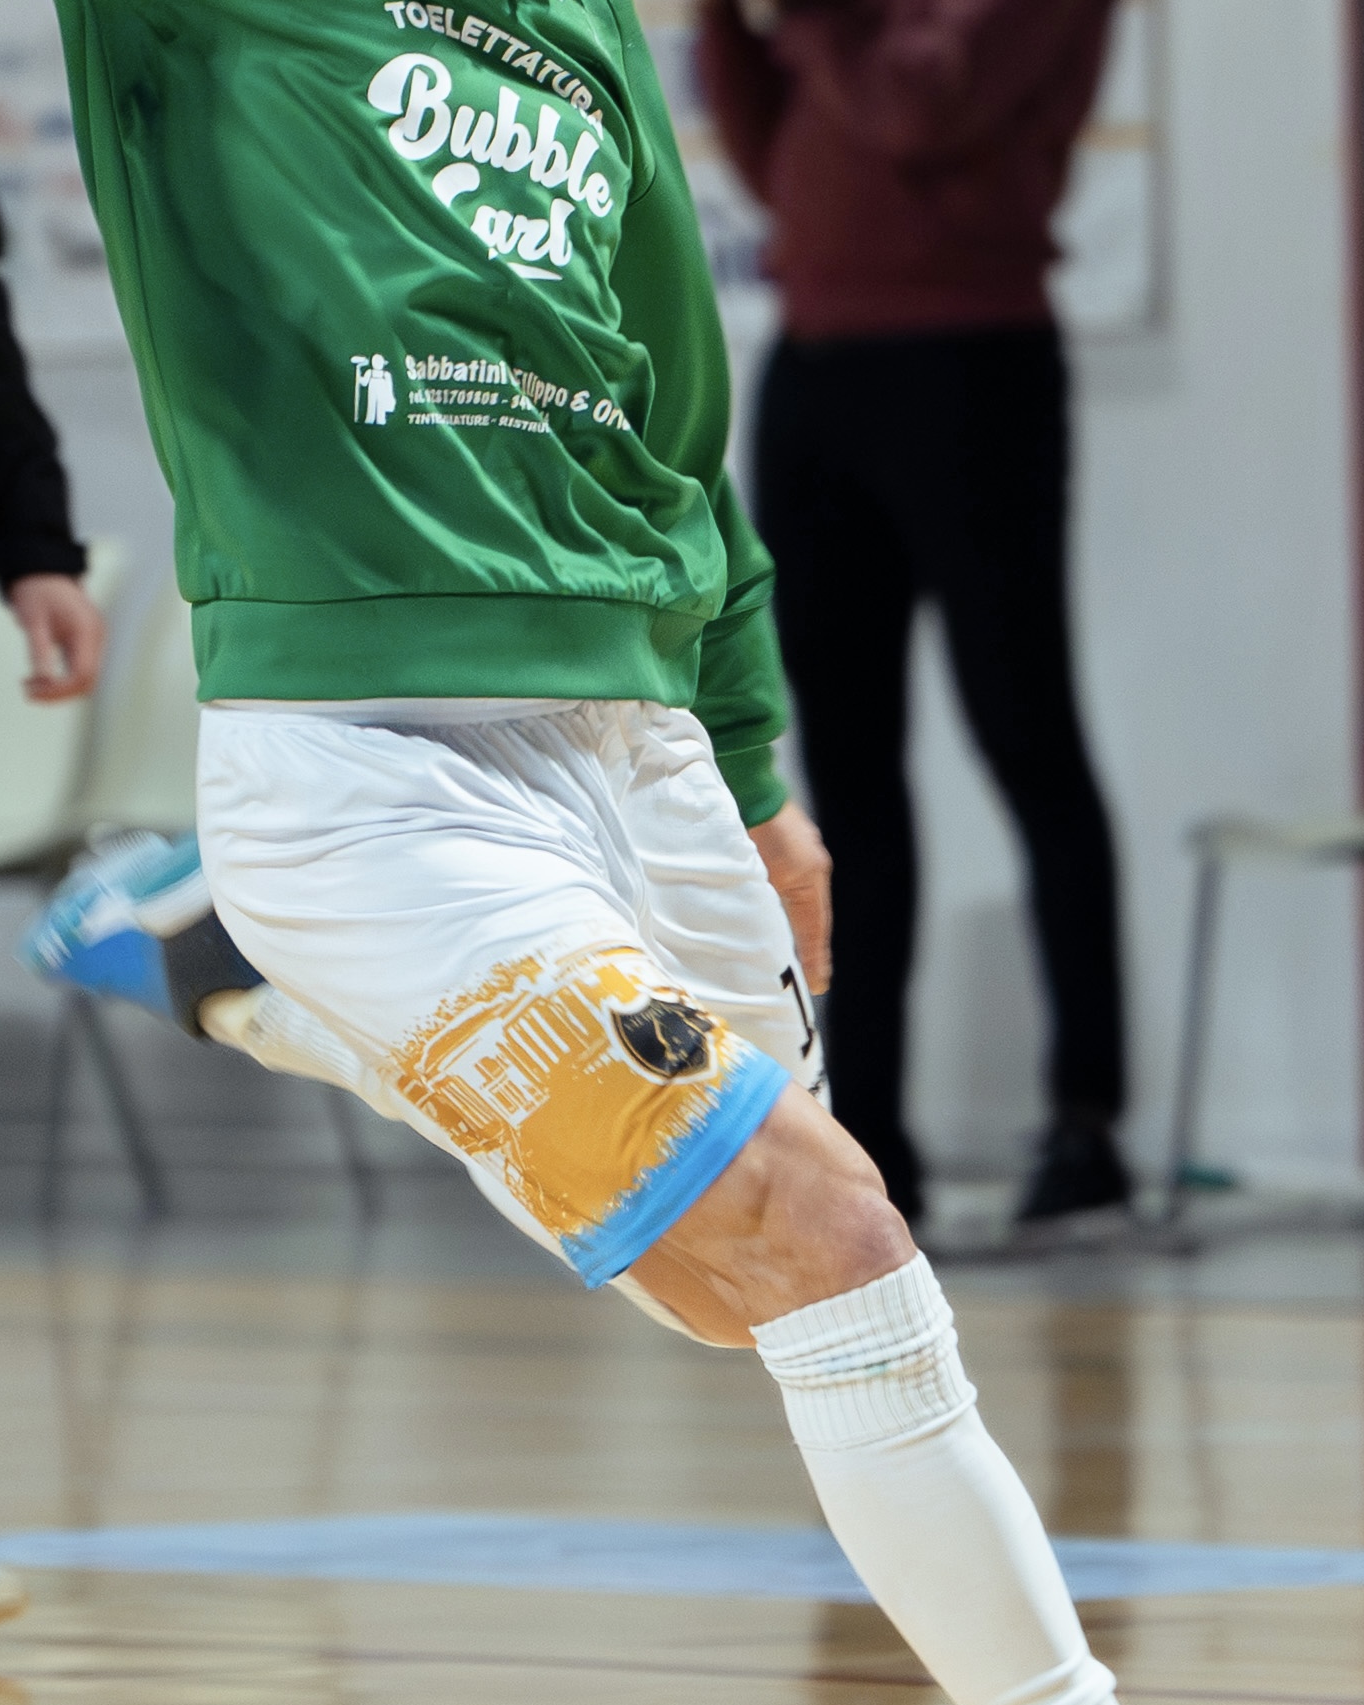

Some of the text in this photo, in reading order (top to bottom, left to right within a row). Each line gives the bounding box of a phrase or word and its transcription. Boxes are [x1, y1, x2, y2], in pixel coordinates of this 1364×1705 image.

[367, 53, 614, 218] Bubble
[384, 0, 604, 141] TOELETTATURA
[404, 354, 507, 385] Sabbatini
[569, 389, 591, 413] &
